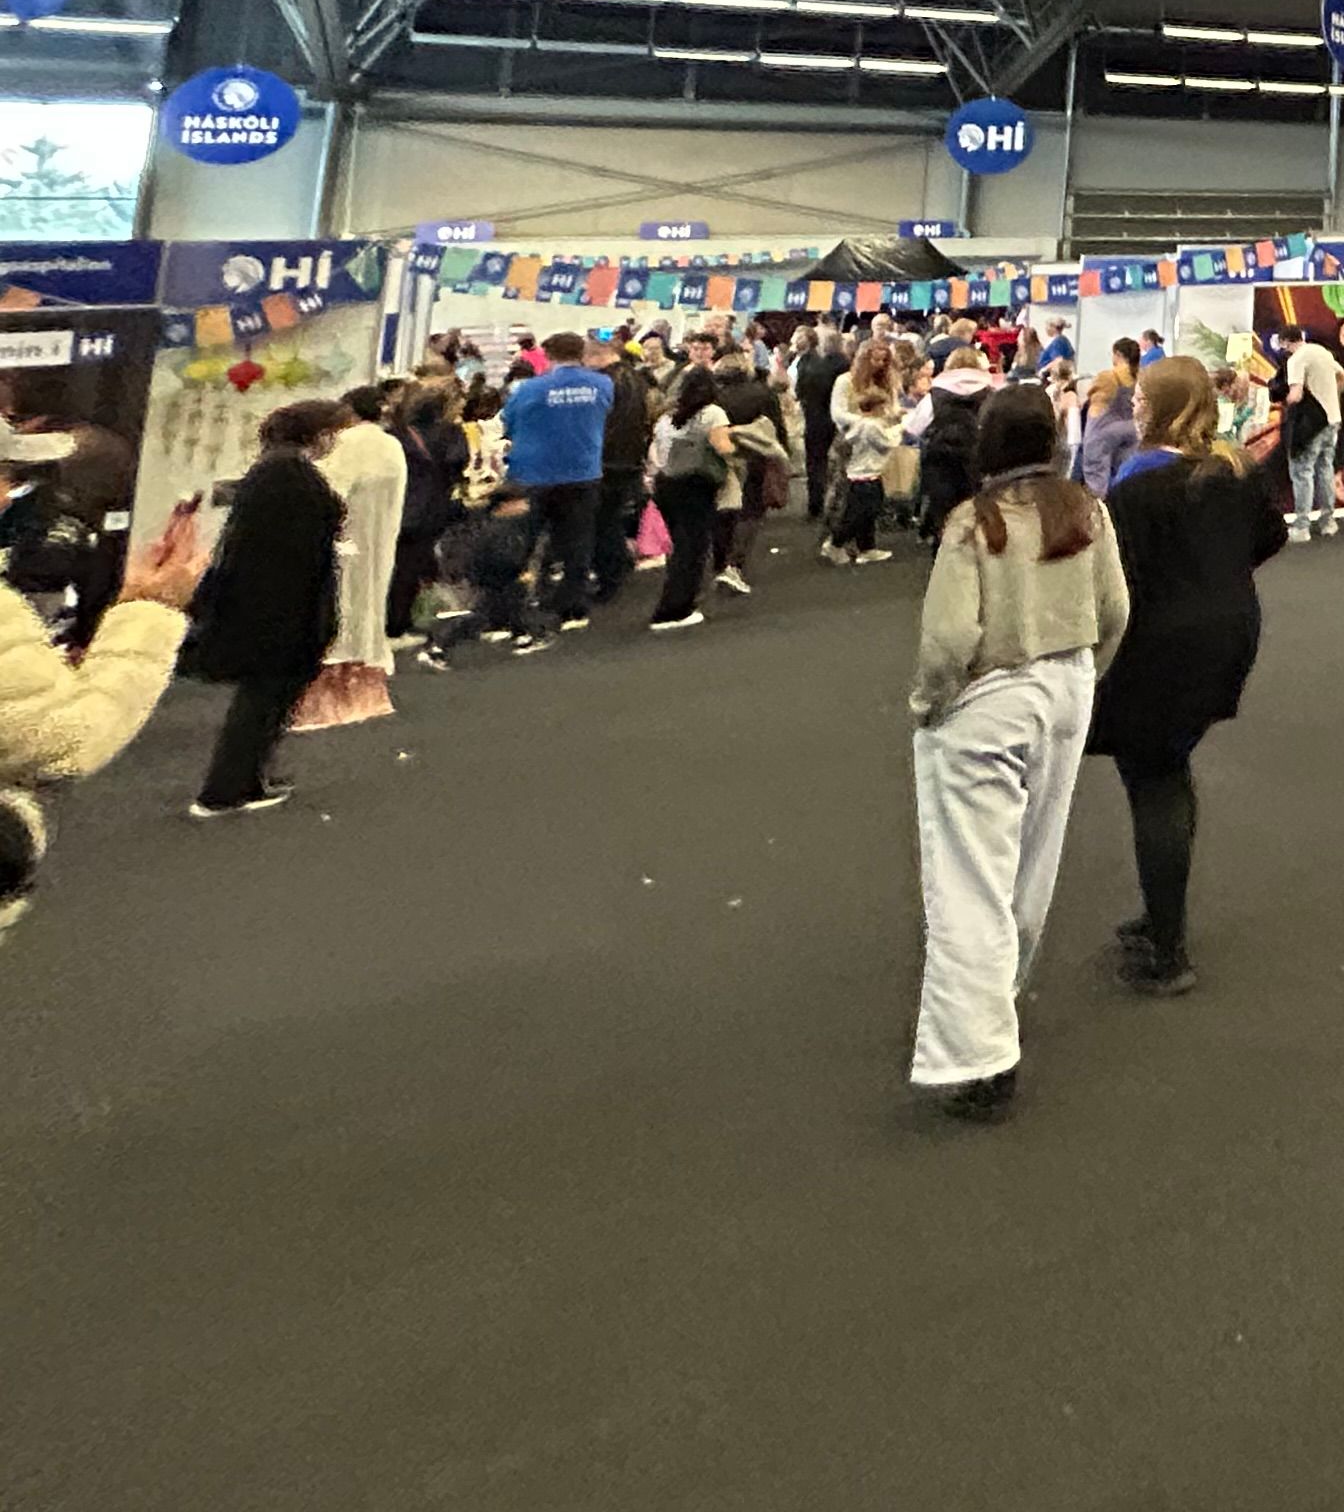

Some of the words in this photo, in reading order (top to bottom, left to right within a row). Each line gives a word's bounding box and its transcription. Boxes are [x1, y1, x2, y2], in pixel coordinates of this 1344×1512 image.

[181, 130, 278, 145] ÍSLANDS
[986, 121, 1025, 152] HÍ
[269, 250, 333, 290] HÍ
